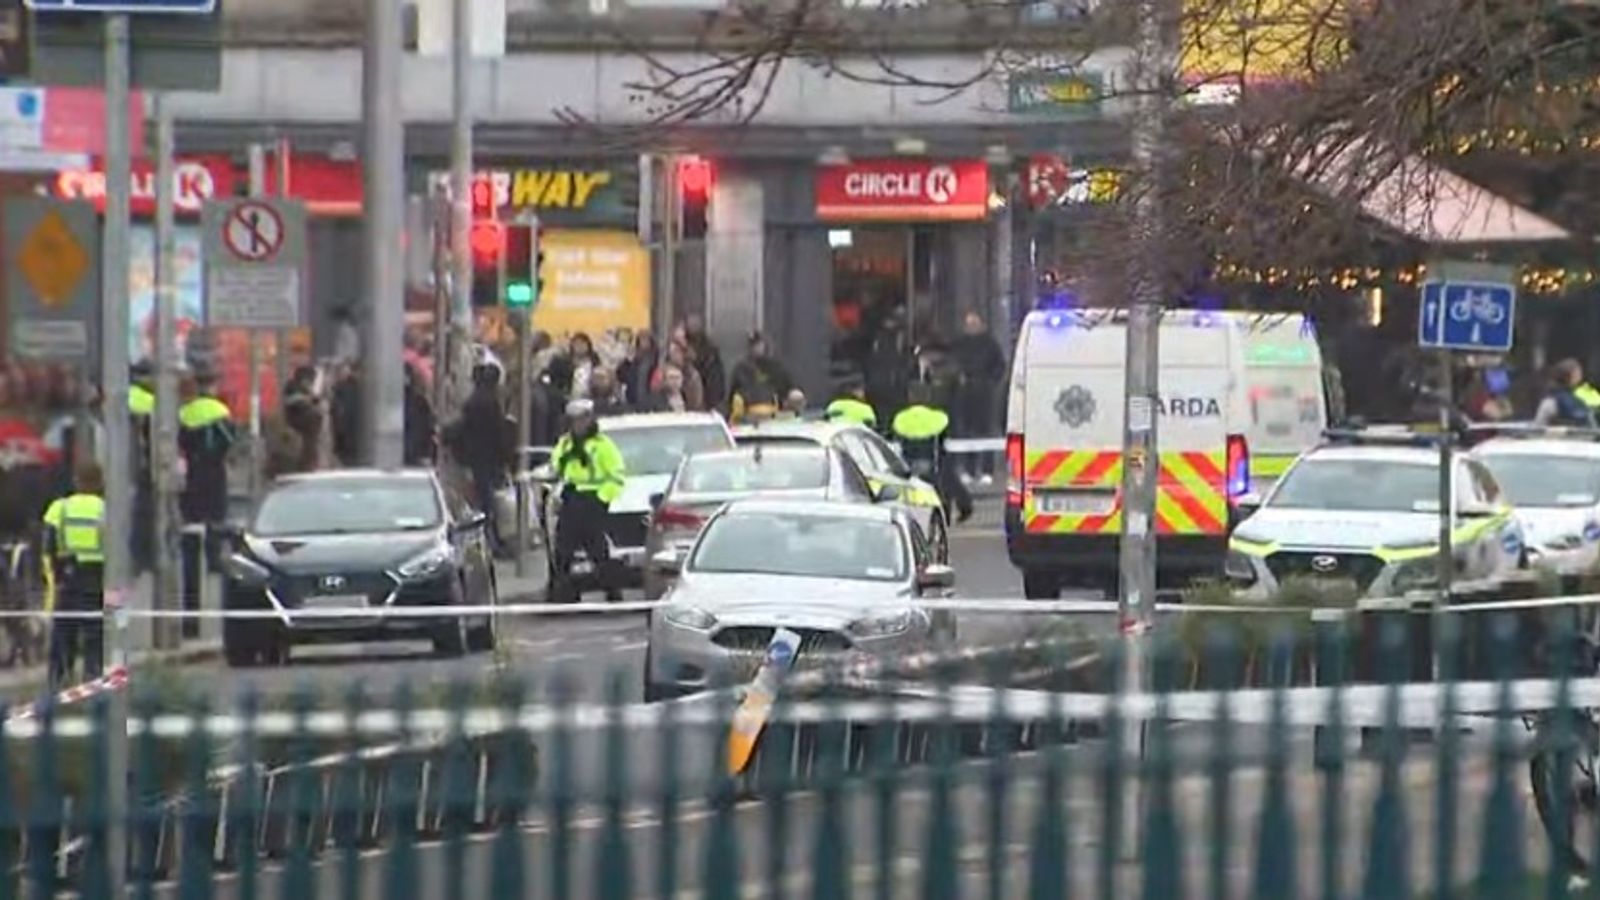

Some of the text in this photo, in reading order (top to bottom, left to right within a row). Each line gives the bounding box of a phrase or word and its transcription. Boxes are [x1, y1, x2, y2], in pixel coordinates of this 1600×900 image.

[57, 171, 156, 198] CIRLE
[428, 170, 610, 207] BWAY
[845, 166, 956, 203] CIRCLE K
[1154, 397, 1221, 416] ARDA
